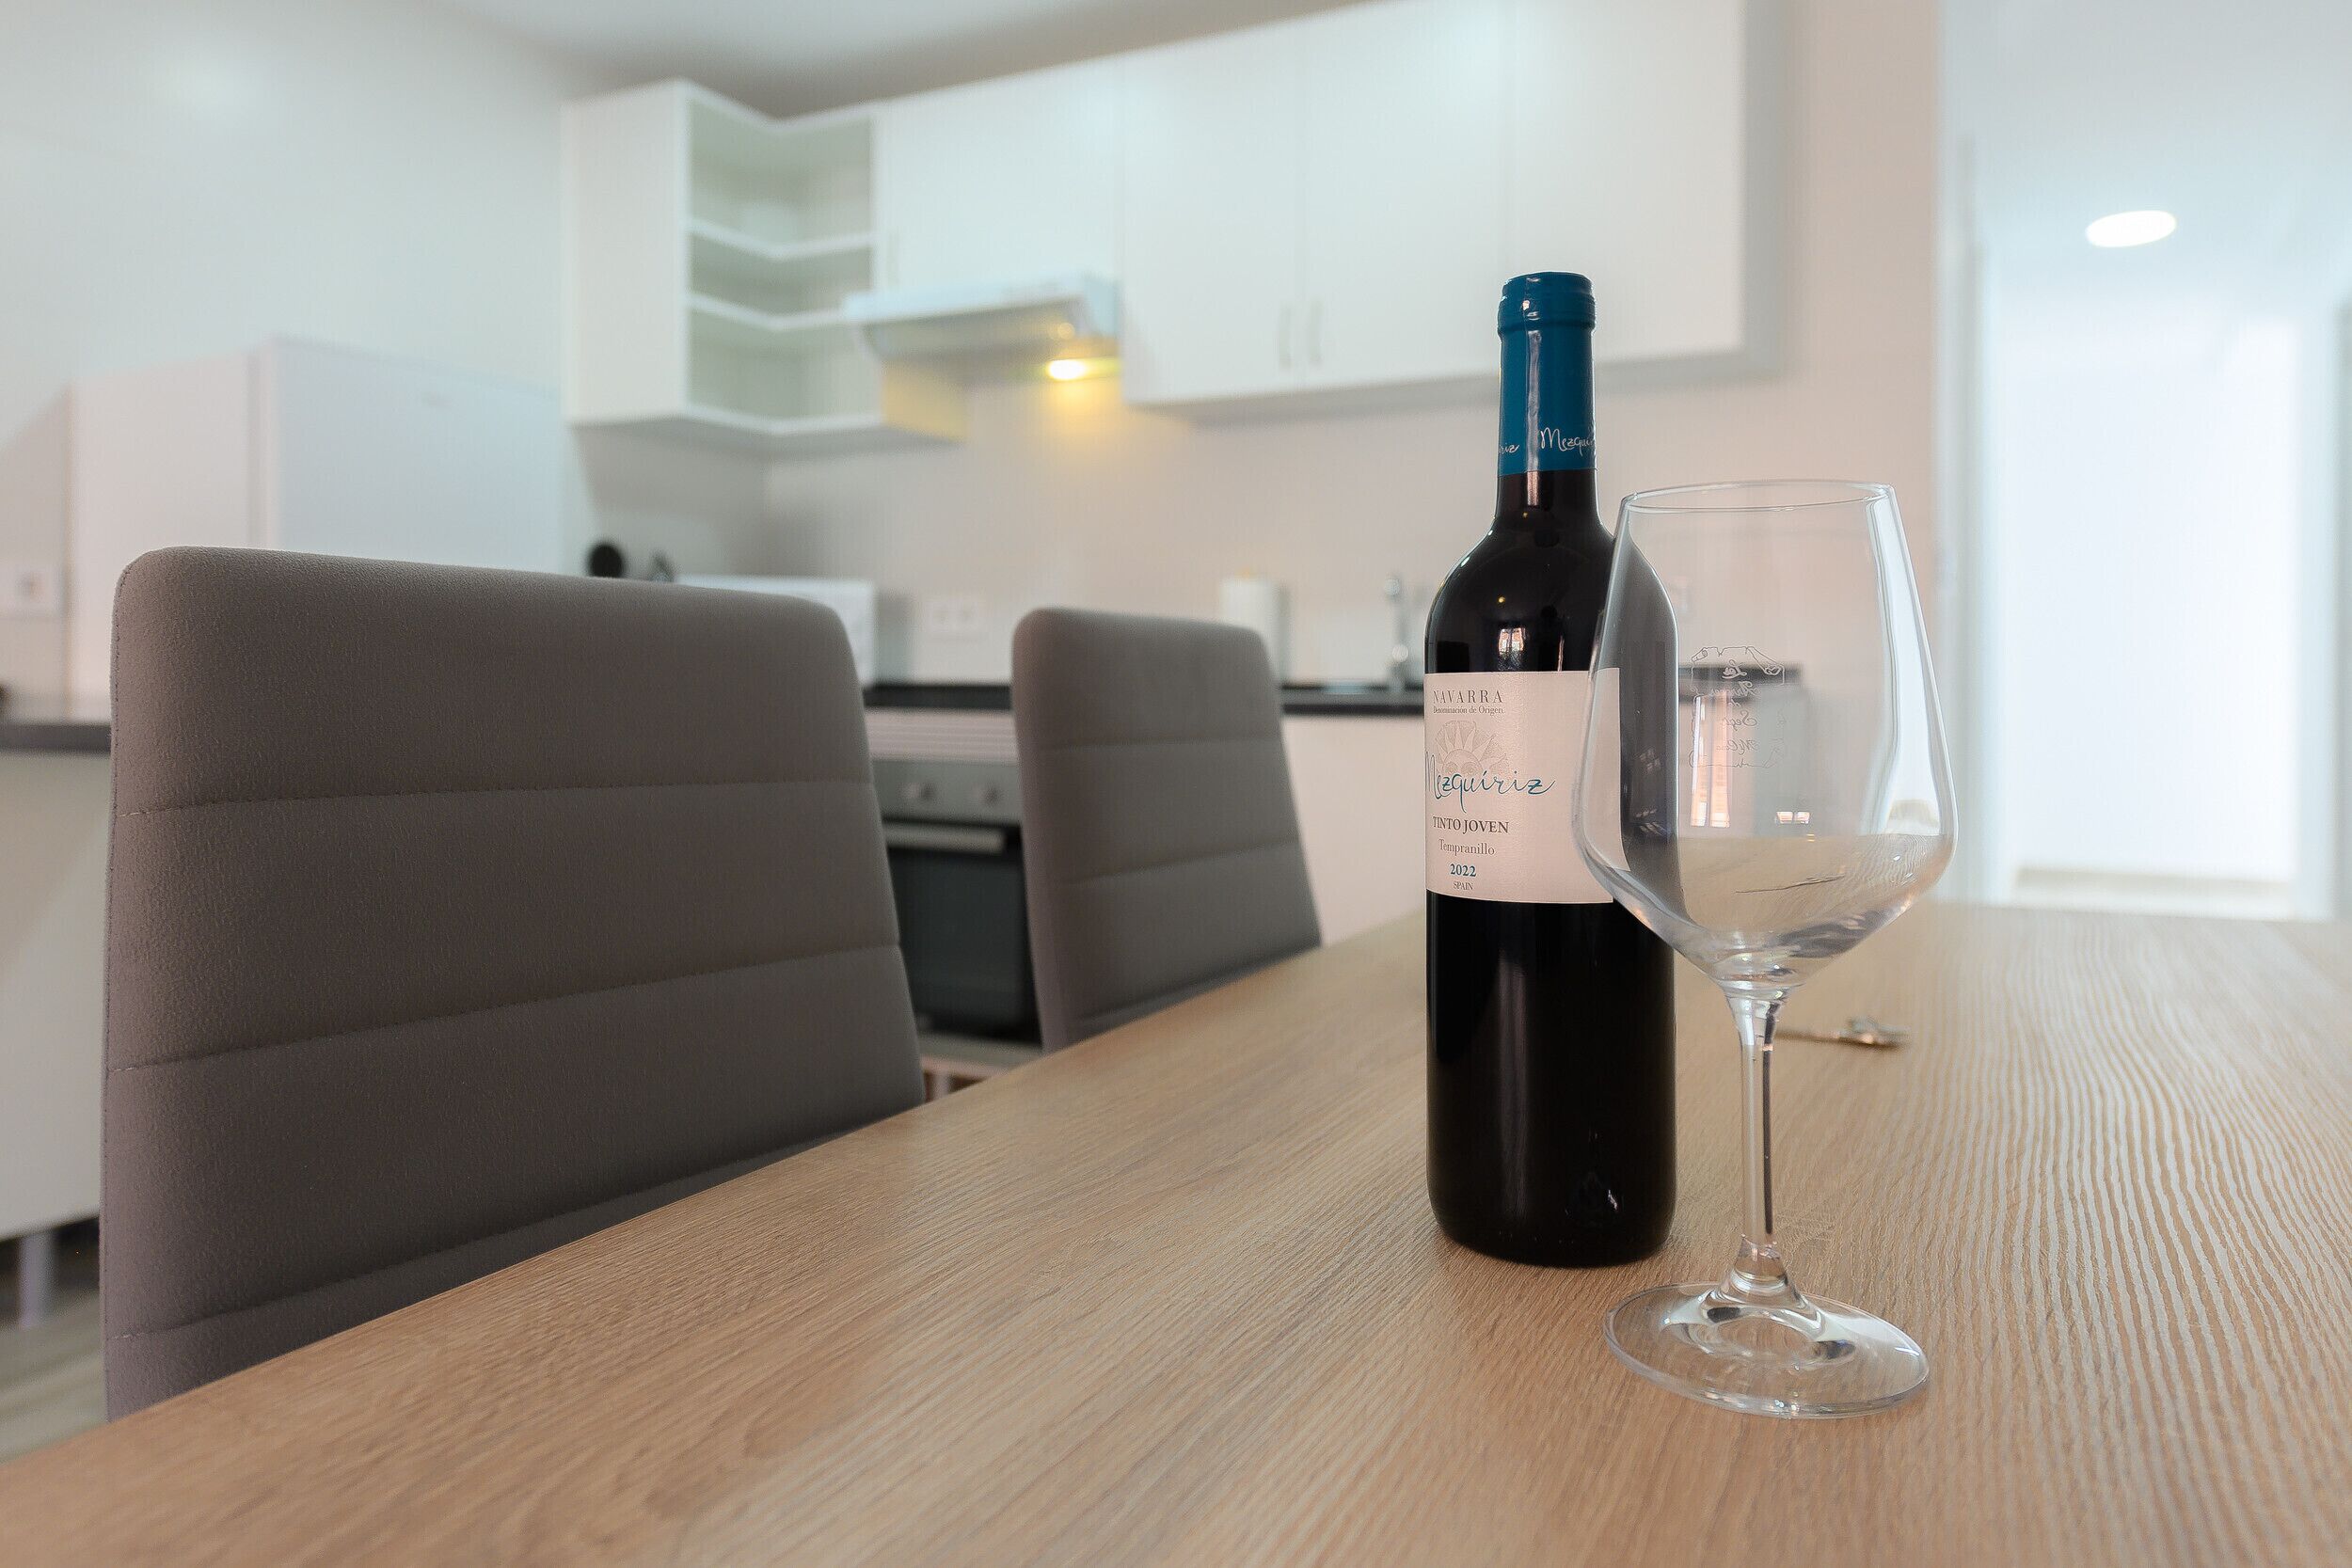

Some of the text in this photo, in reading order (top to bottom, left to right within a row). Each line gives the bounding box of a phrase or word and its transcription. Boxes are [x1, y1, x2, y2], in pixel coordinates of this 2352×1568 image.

[1433, 689, 1503, 704] NAVARRA
[1433, 705, 1504, 717] Denominación de Origen
[1433, 816, 1509, 834] TINTO JOVEN
[1438, 839, 1495, 856] Tempranillo
[1450, 863, 1476, 878] 2022
[1454, 880, 1474, 891] SPAIN
